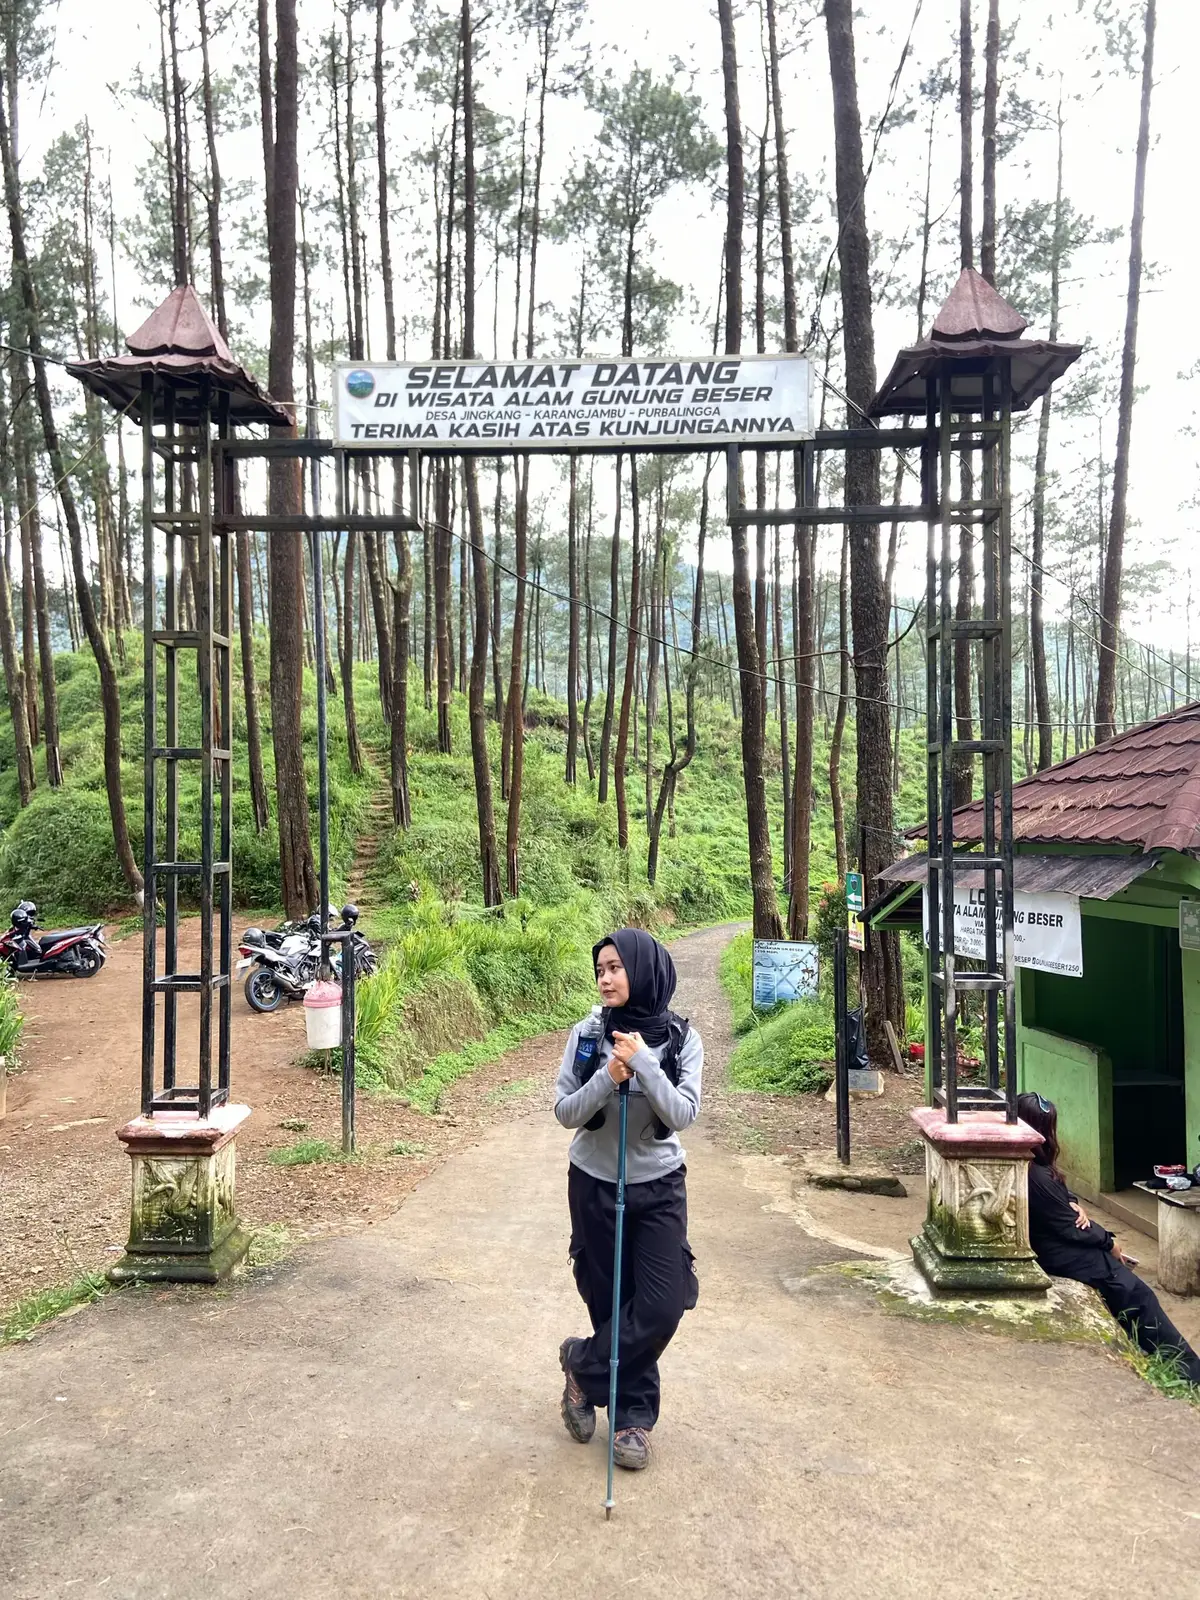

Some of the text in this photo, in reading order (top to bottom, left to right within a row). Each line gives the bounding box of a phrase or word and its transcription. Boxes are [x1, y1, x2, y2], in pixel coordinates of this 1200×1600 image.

[405, 361, 742, 389] SELAMAT DATANG
[373, 386, 774, 408] DI WISATA ALAM GUNUNG BESER
[425, 410, 457, 421] DESA
[460, 410, 522, 420] JINGKANG
[533, 408, 626, 420] KARANGJAMBU
[637, 406, 721, 418] PURBALINGGA
[350, 417, 796, 439] TERIMA KASIH ATAS KUNJUNGANNYA
[1027, 912, 1064, 928] BESER
